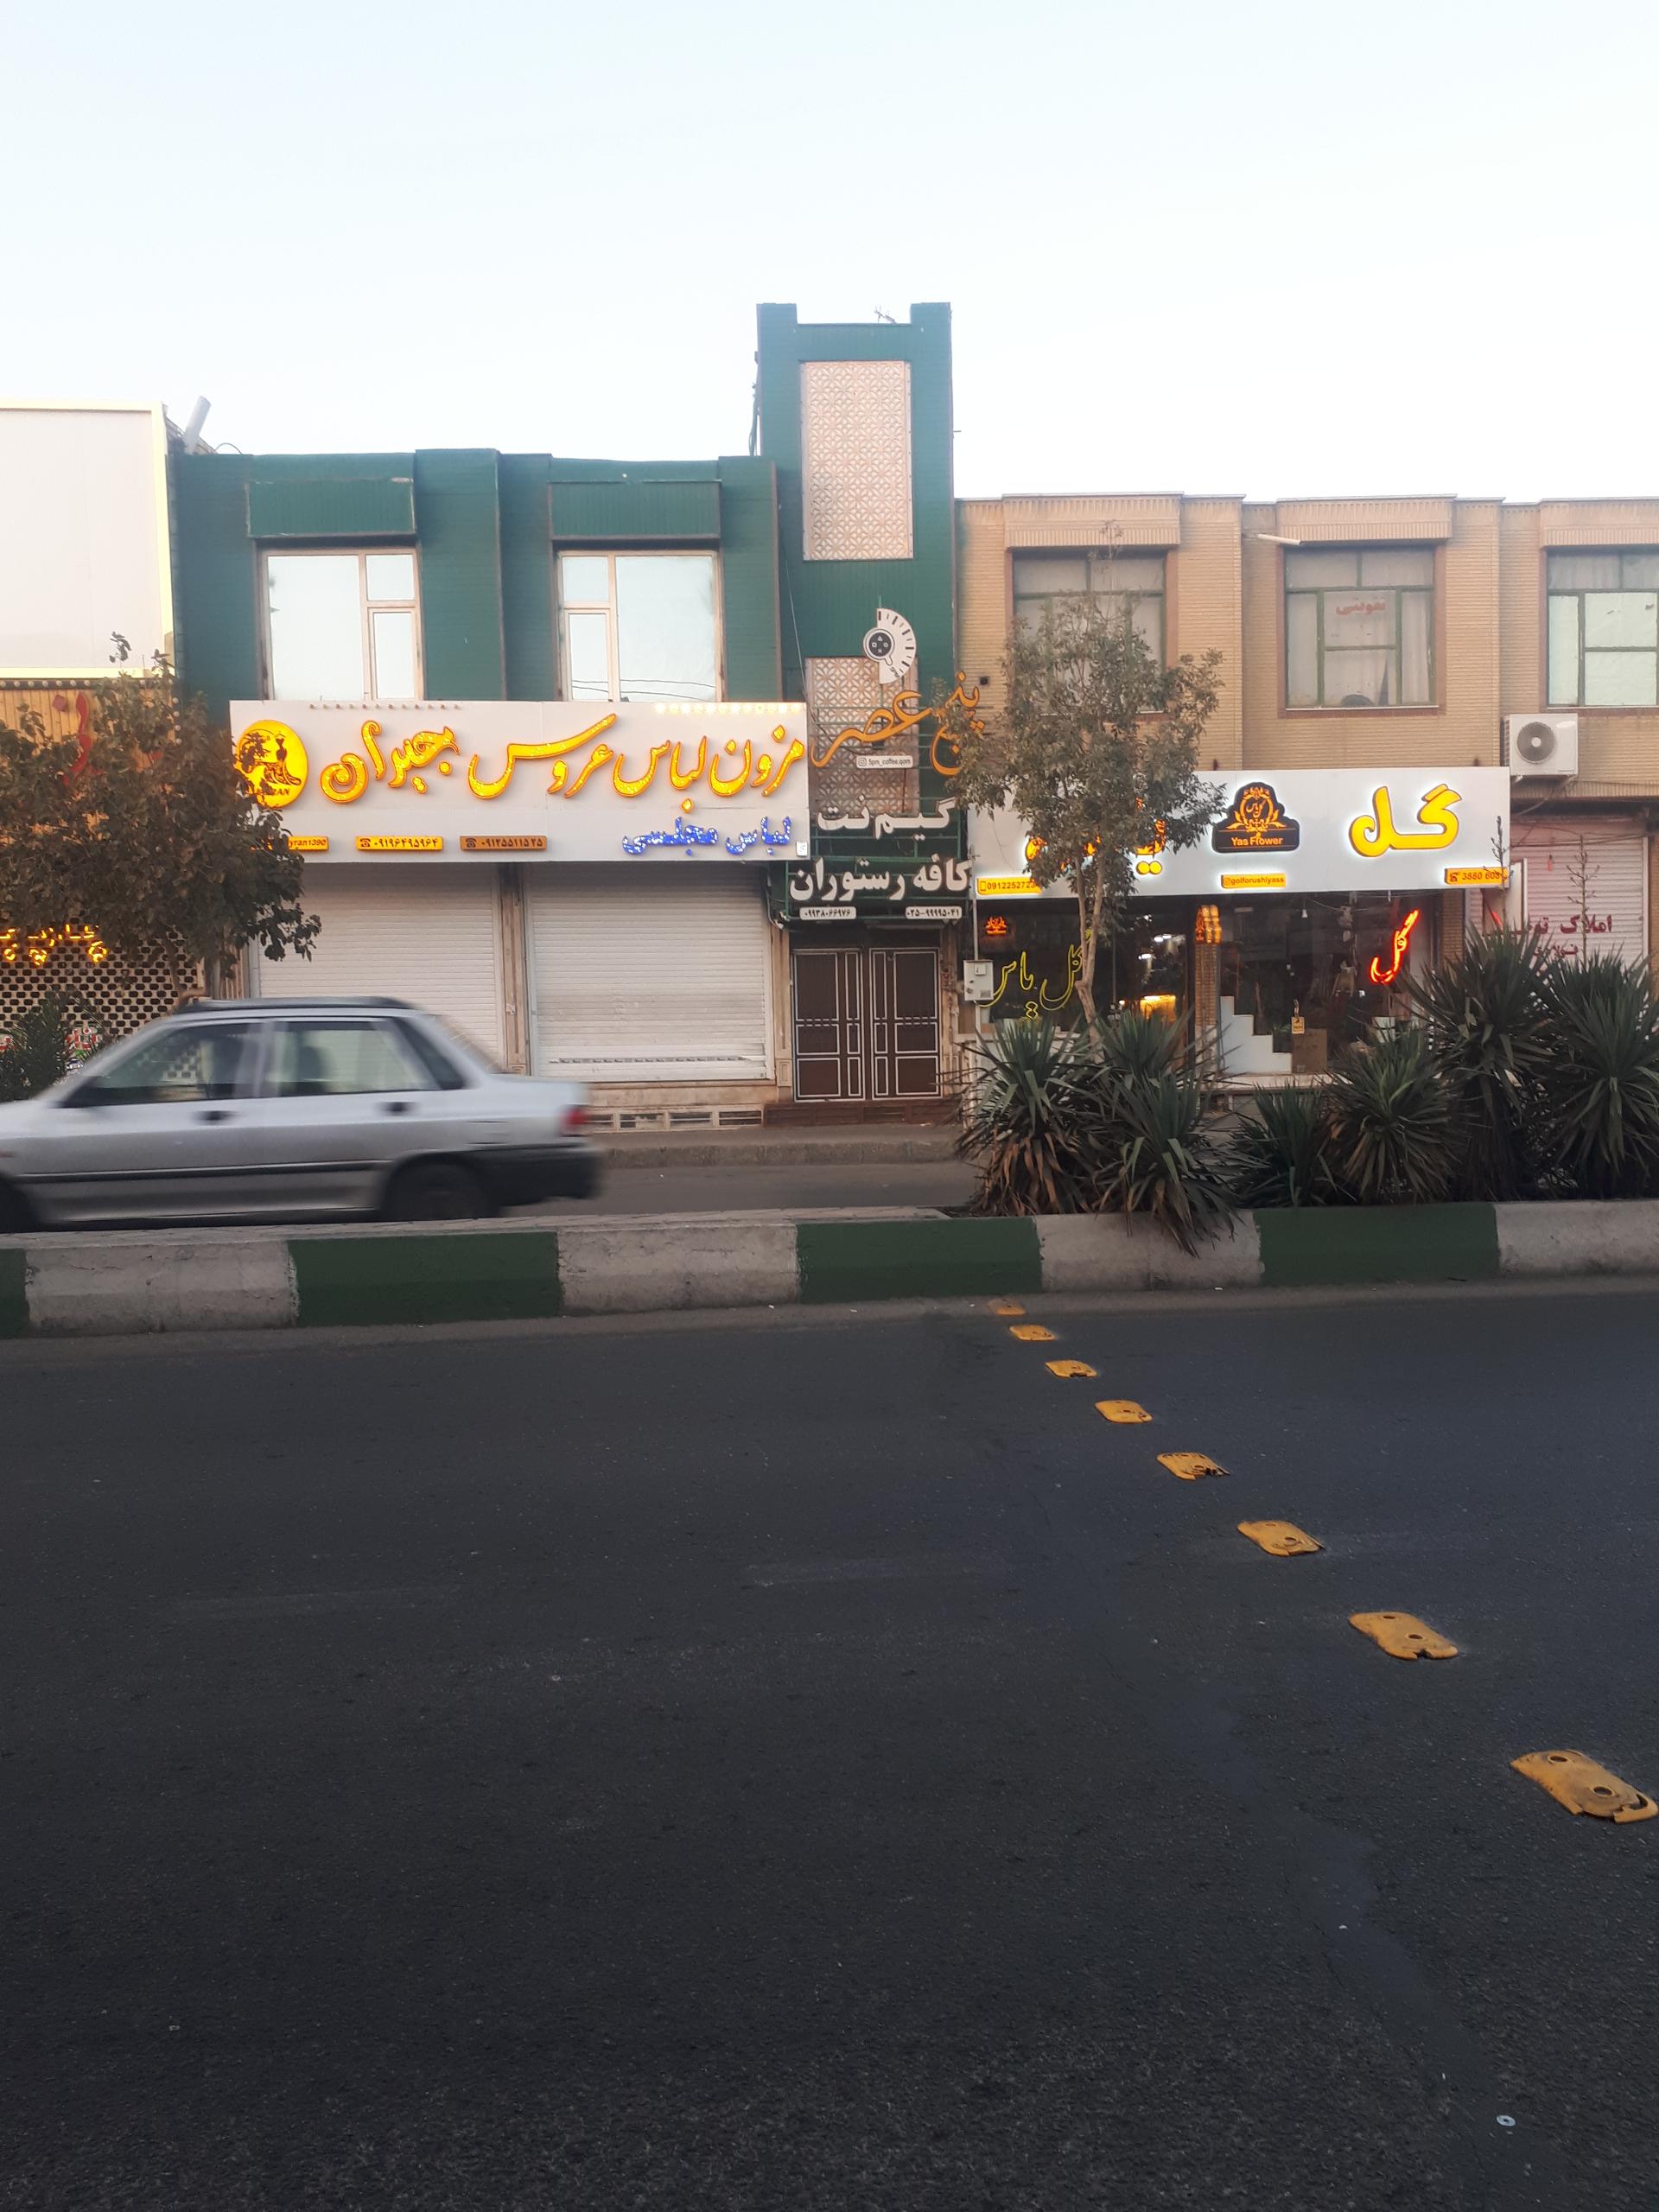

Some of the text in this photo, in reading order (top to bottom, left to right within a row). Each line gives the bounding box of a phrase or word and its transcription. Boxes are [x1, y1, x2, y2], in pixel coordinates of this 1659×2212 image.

[810, 690, 931, 768] عصر
[320, 713, 805, 813] مزون لباس عروس جیران
[622, 816, 792, 856] لباس مجلسی
[817, 794, 957, 840] گیم نت
[1349, 783, 1463, 857] گل
[289, 838, 327, 848] yran1390
[1231, 836, 1284, 847] Yas Flower
[790, 853, 972, 901] کافه رستوران
[987, 880, 1037, 890] 0912252723
[1230, 875, 1285, 885] golforushiyass
[1462, 872, 1483, 880] 3880
